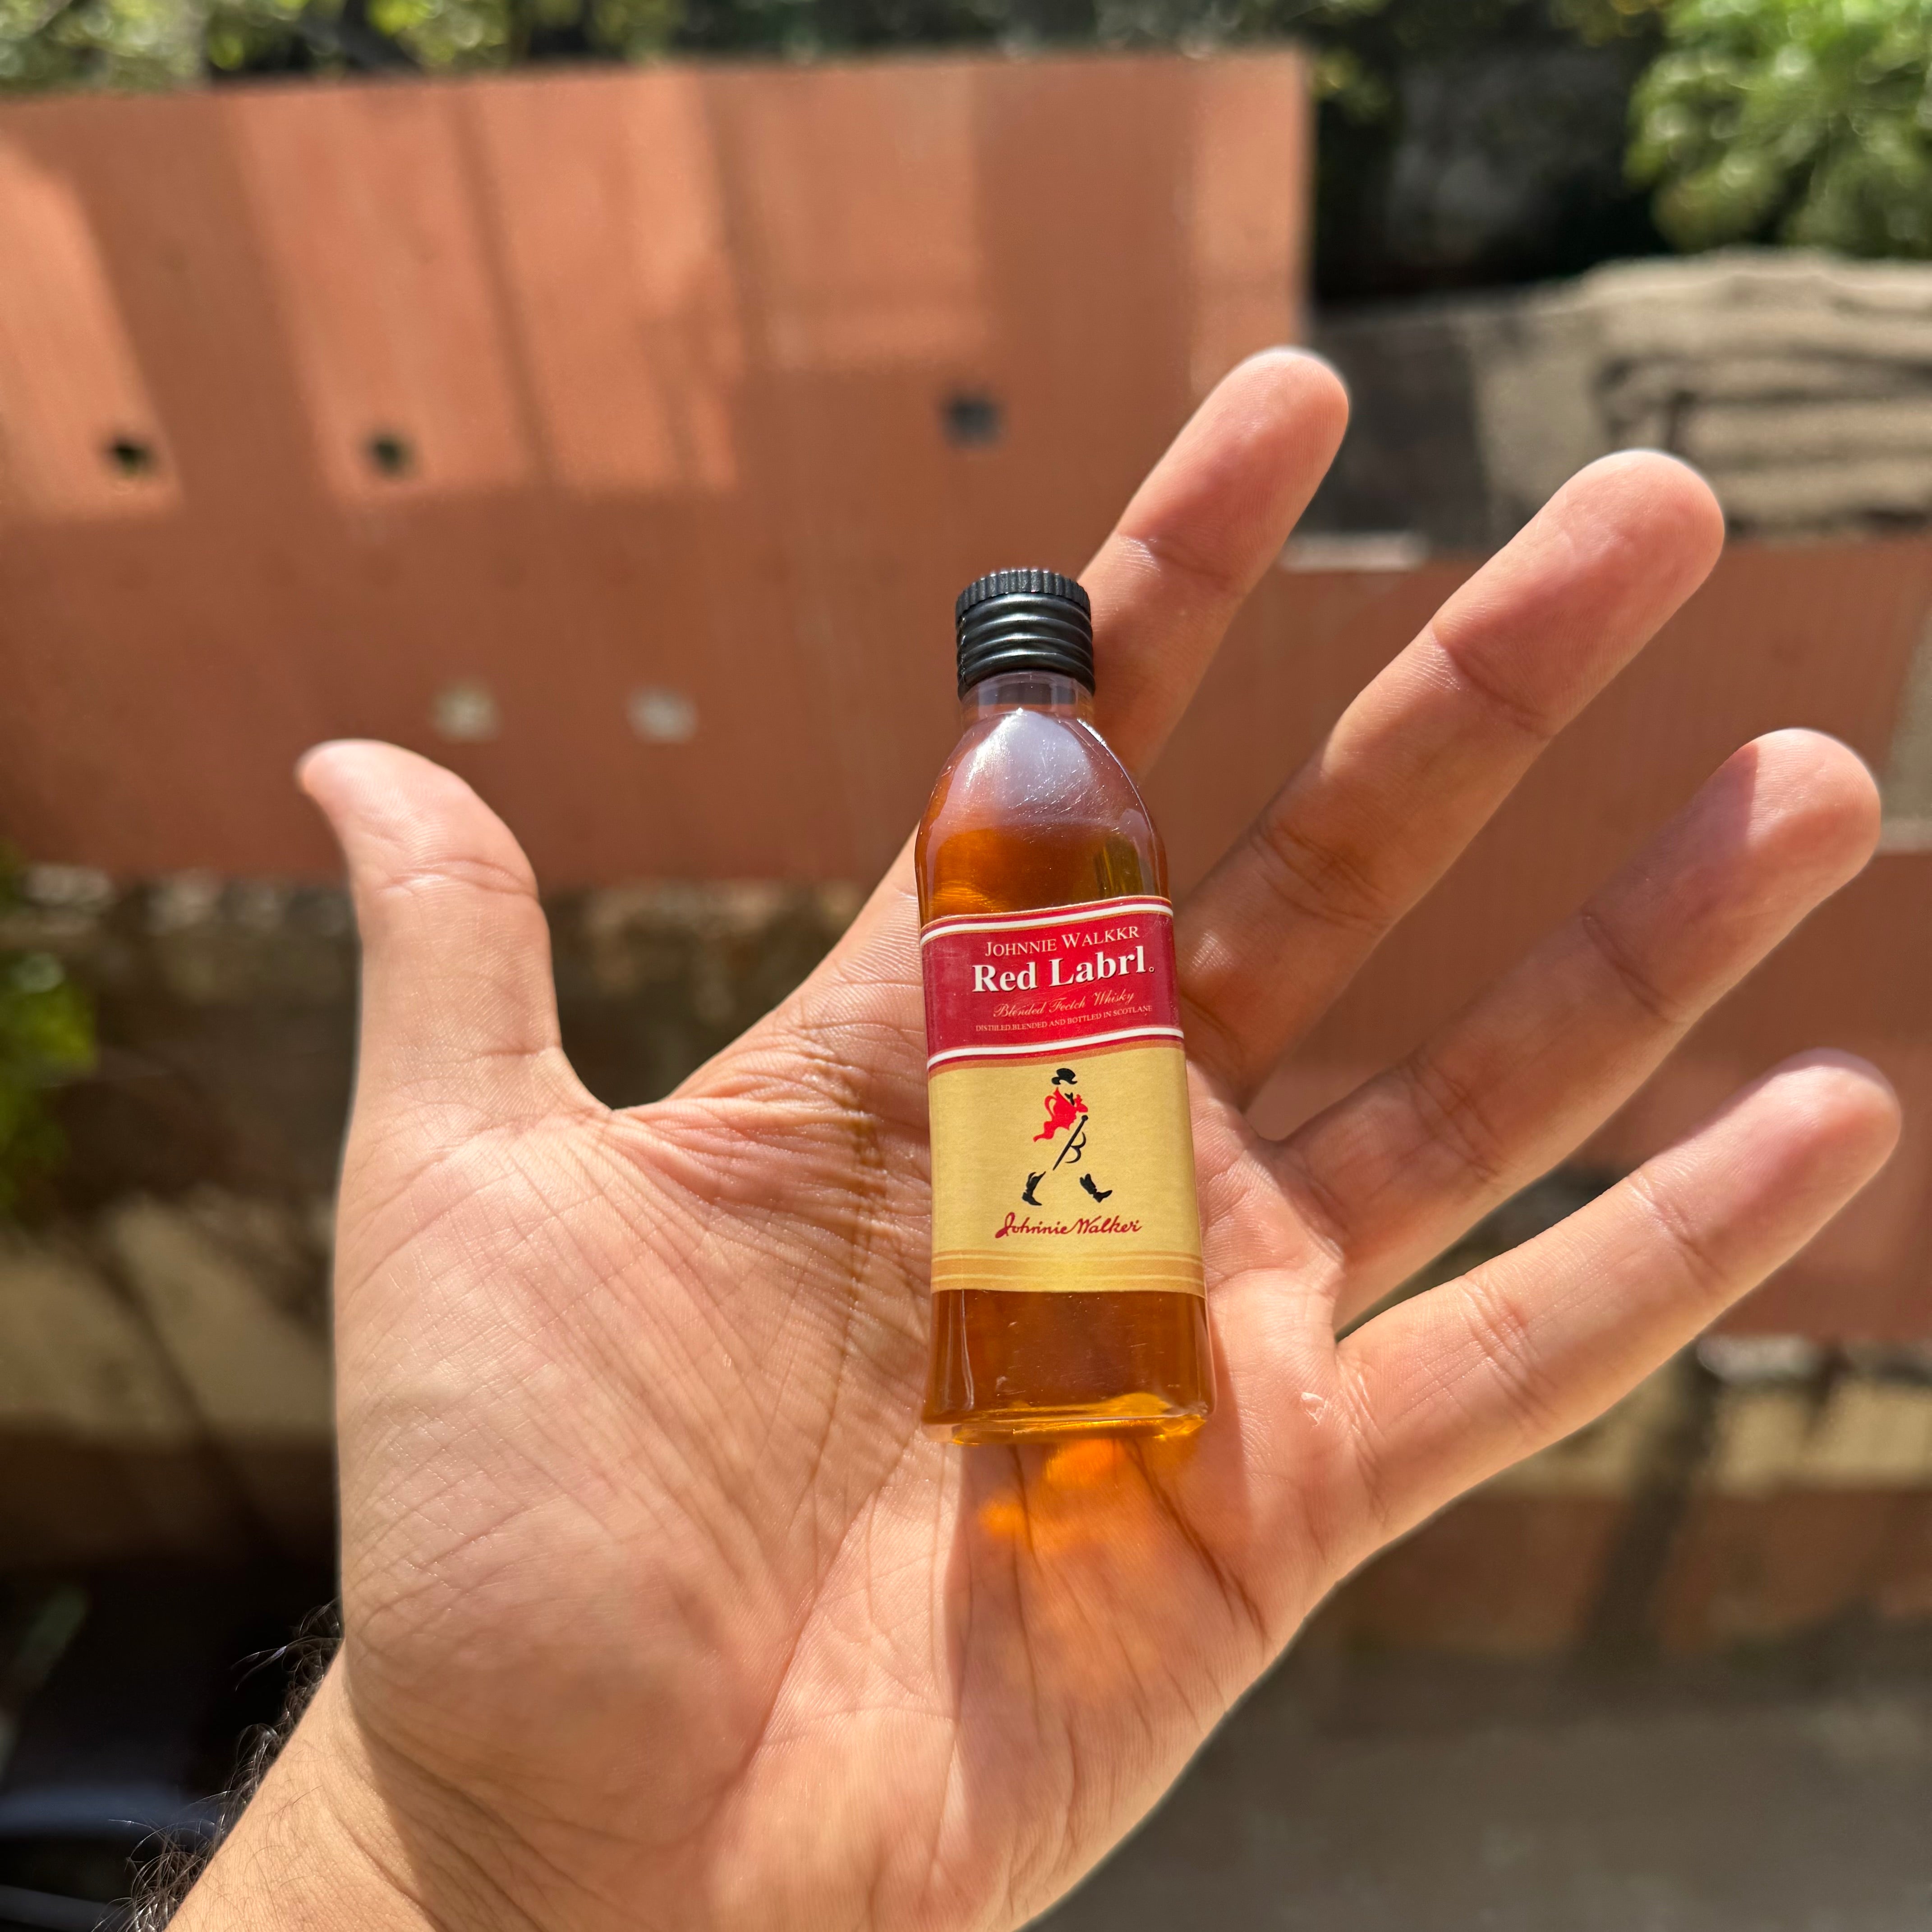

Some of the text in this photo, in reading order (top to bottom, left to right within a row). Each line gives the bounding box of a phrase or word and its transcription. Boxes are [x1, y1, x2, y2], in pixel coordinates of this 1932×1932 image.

[985, 926, 1140, 957] JOHNNIE WALKKR
[972, 961, 1038, 993] Red
[994, 1002, 1047, 1017] Blended
[1093, 989, 1135, 1007] Whisky
[1067, 1013, 1102, 1024] BOTTLED
[994, 1212, 1143, 1239] Johnnie Walker
